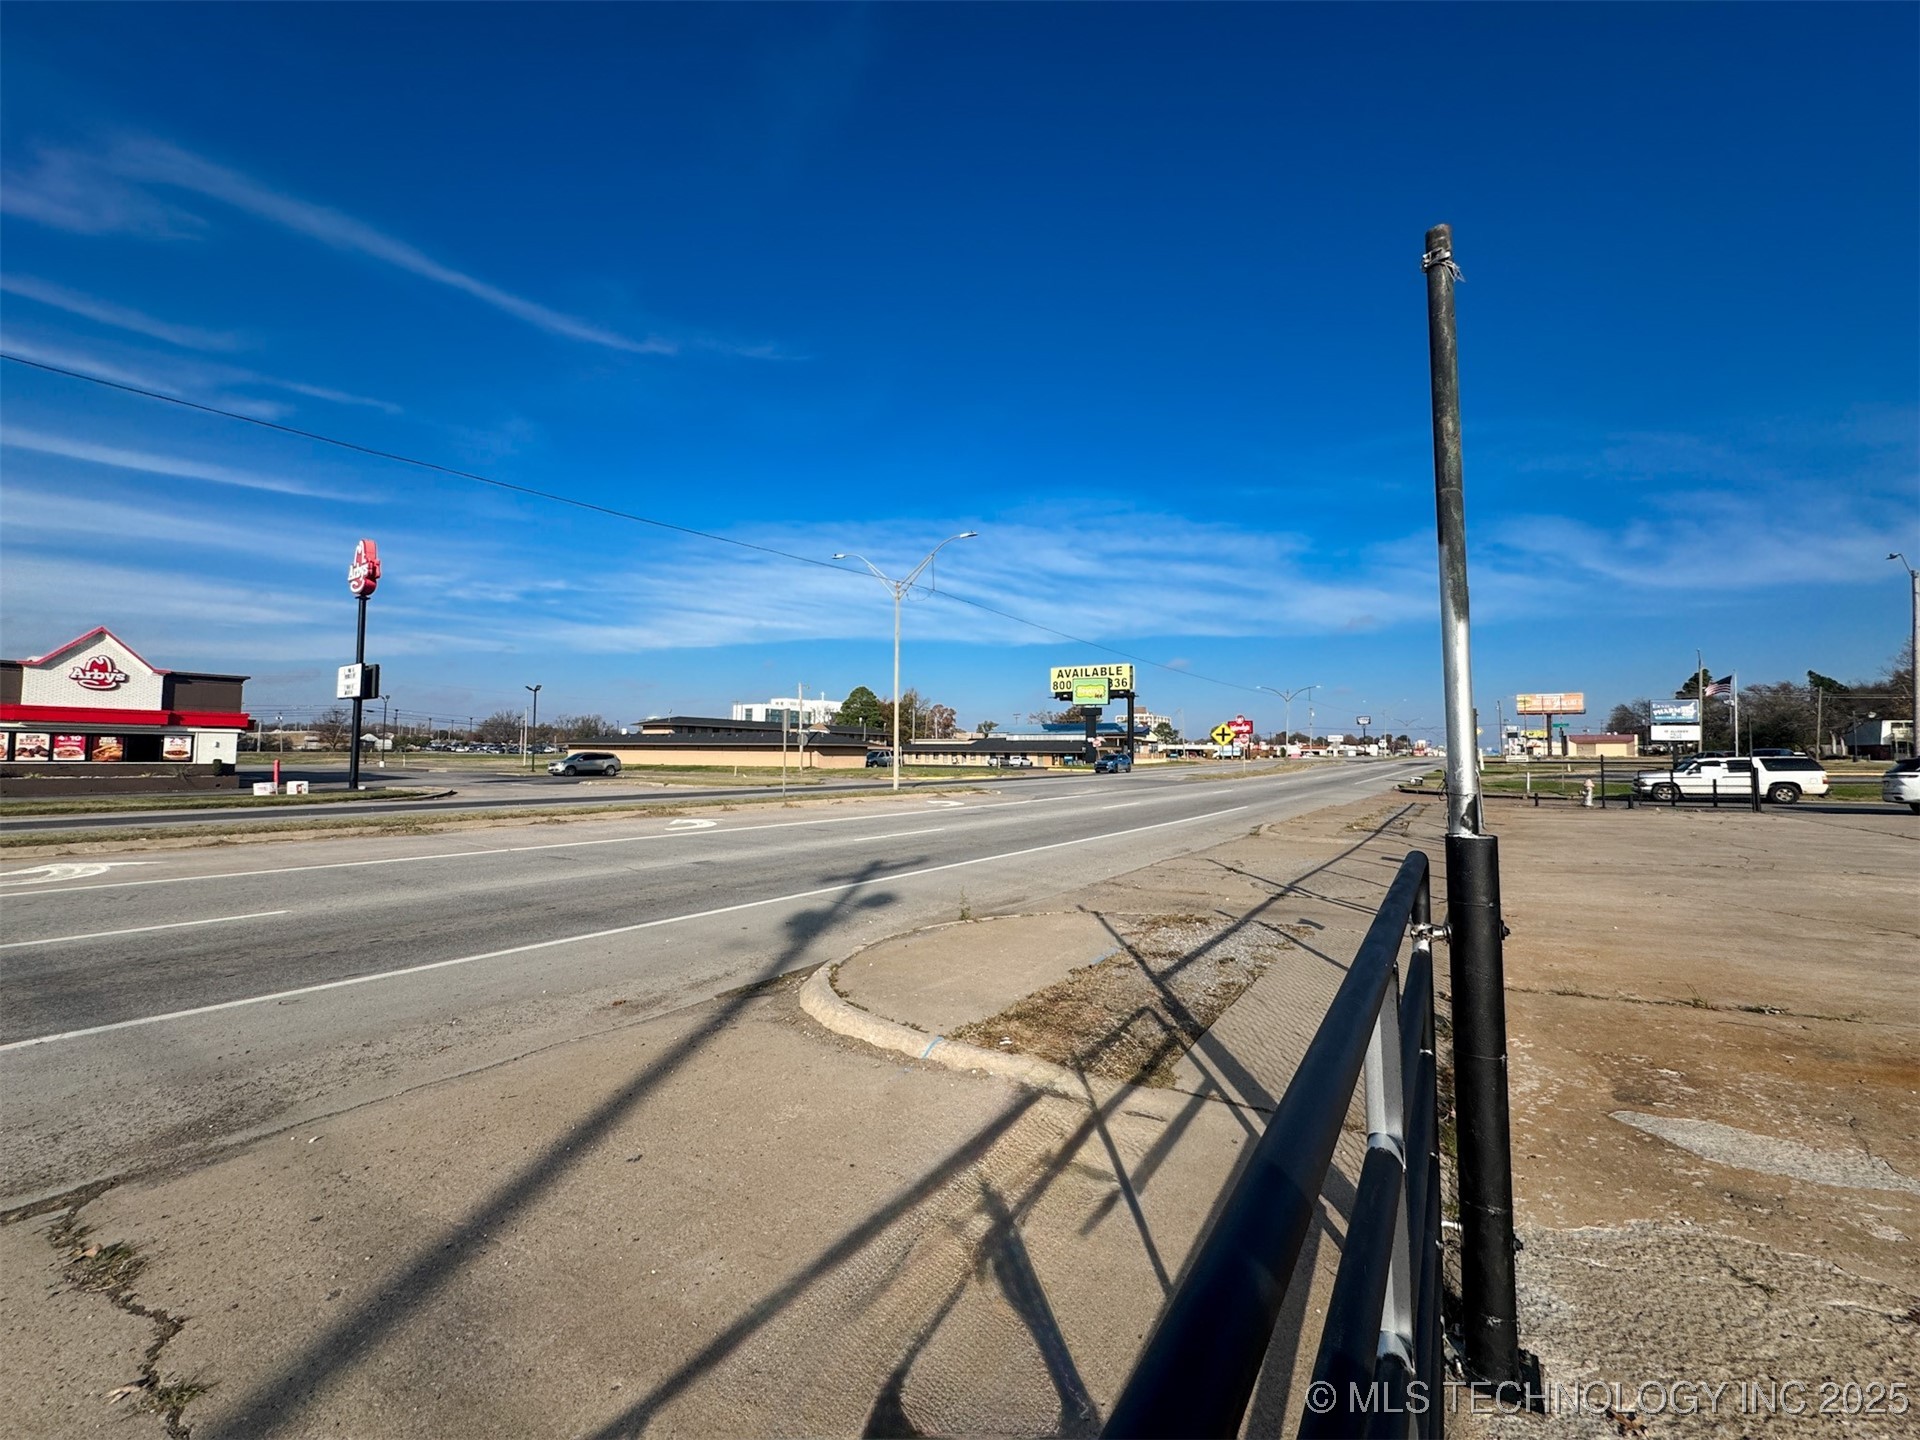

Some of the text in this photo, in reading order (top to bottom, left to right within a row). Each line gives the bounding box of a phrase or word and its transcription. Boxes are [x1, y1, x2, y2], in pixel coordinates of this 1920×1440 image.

[70, 667, 126, 683] Arby's
[1057, 666, 1123, 679] AVAILABLE
[1052, 680, 1072, 691] 800
